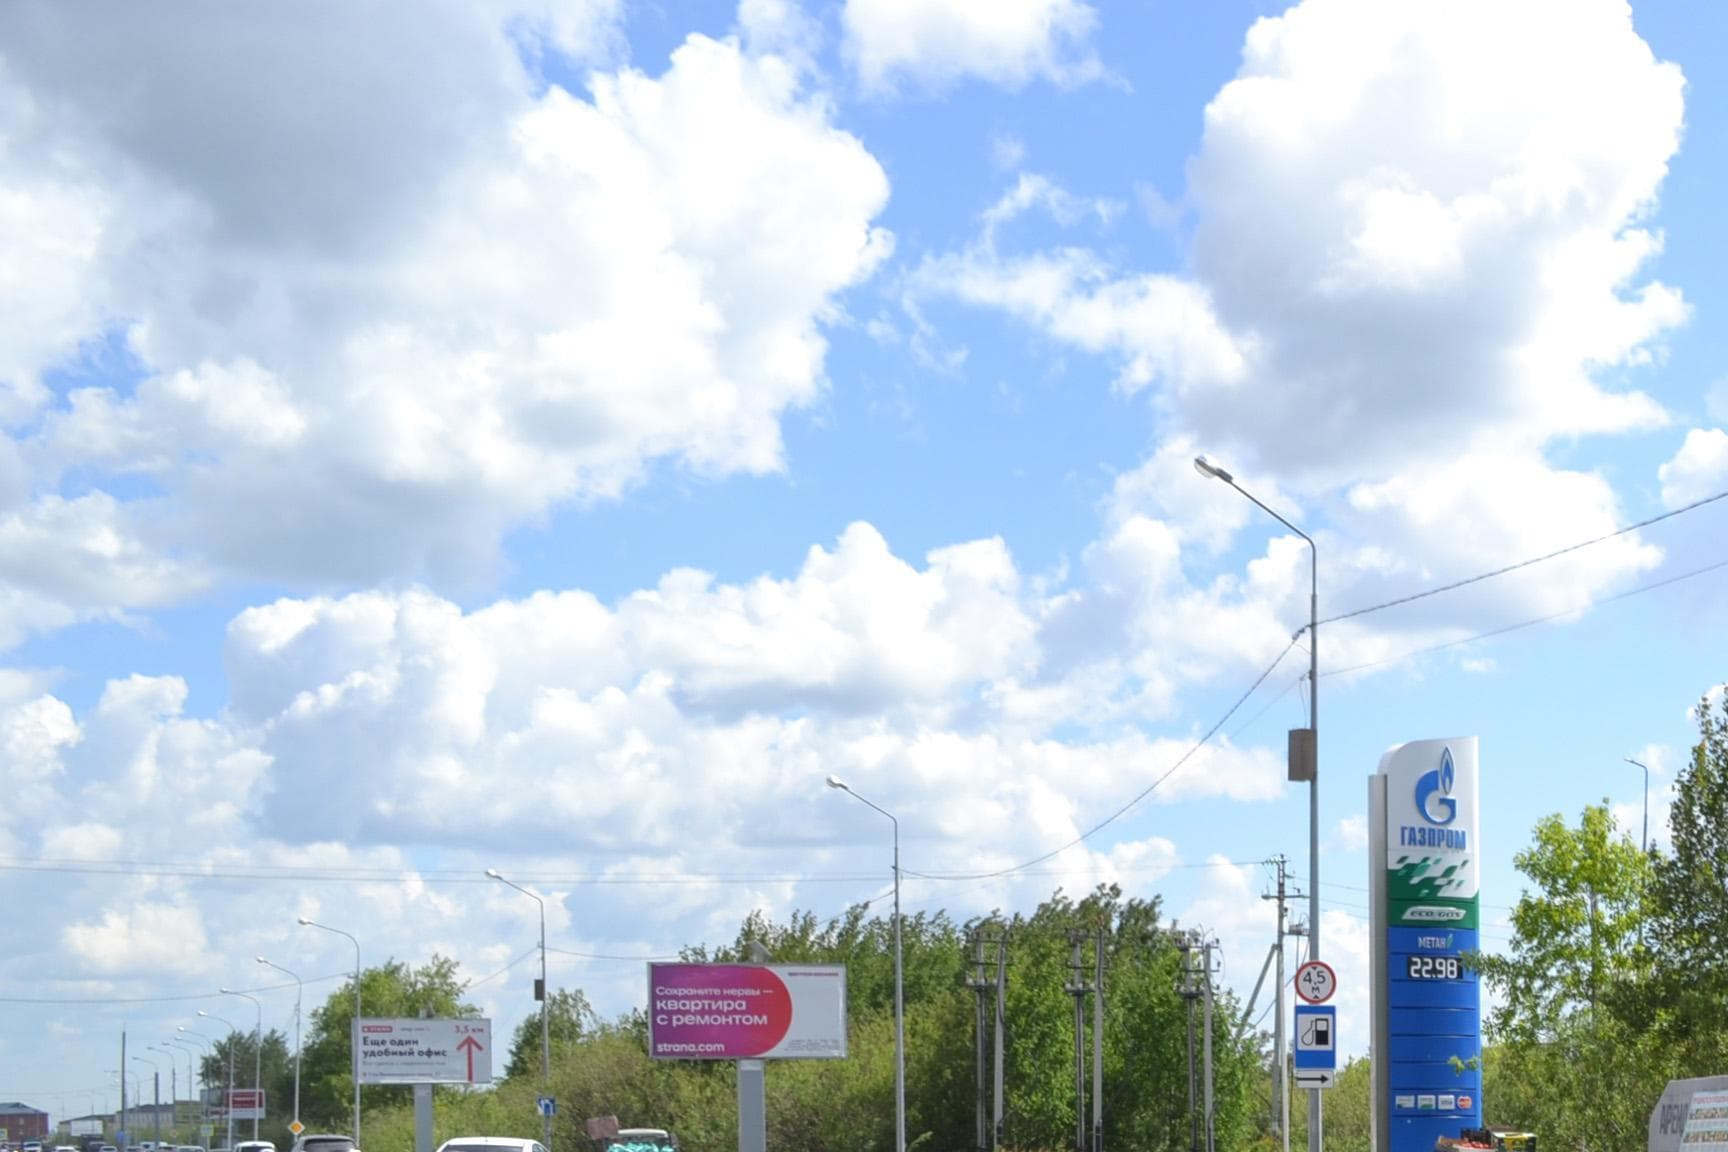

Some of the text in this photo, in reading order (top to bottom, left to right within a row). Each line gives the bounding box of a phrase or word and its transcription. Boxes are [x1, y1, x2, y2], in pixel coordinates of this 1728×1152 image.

[1400, 826, 1467, 850] ГАЗПРОМ
[1417, 936, 1446, 949] МЕТАН
[1410, 957, 1458, 979] 22.98
[655, 986, 721, 997] Сохраните
[723, 988, 761, 997] нервы
[656, 1000, 747, 1013] квартира
[656, 1014, 768, 1027] с ремонтом
[363, 1036, 419, 1047] Еще один
[656, 1043, 725, 1053] strana.com
[362, 1047, 448, 1058] удобный офис
